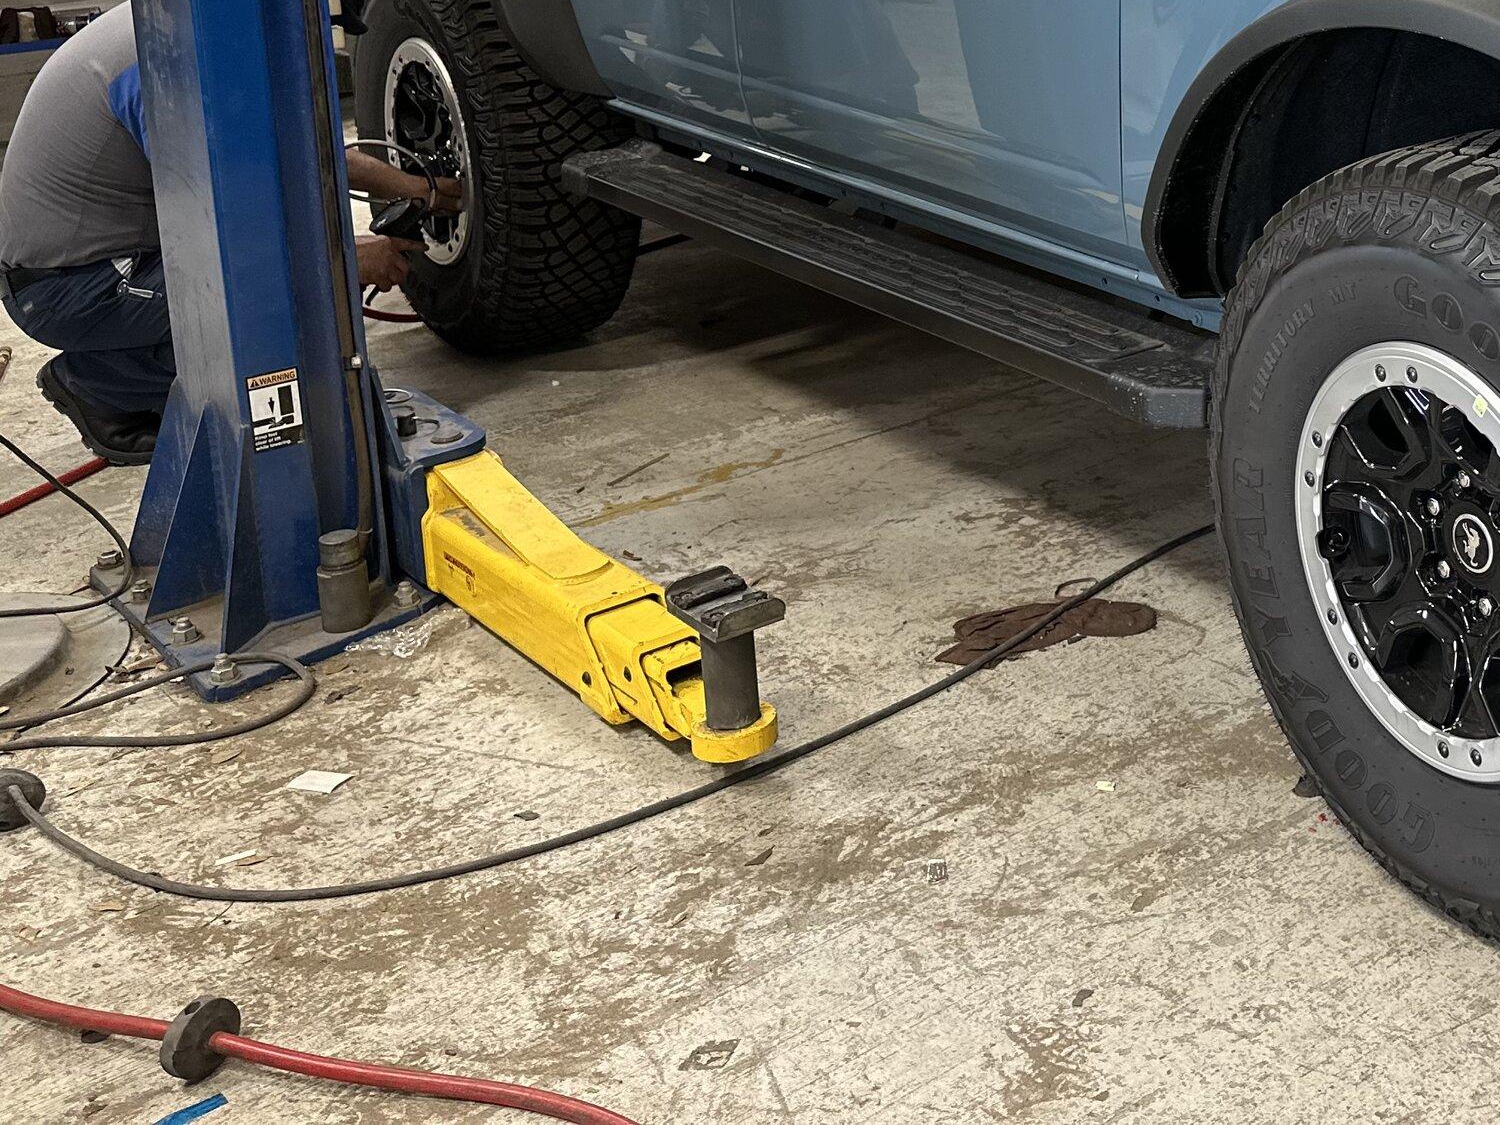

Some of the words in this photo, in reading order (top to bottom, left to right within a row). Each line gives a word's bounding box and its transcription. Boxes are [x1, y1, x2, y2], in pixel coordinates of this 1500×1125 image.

[259, 371, 295, 385] WARNING
[1248, 297, 1317, 415] TERRITORY
[1328, 282, 1357, 305] MT
